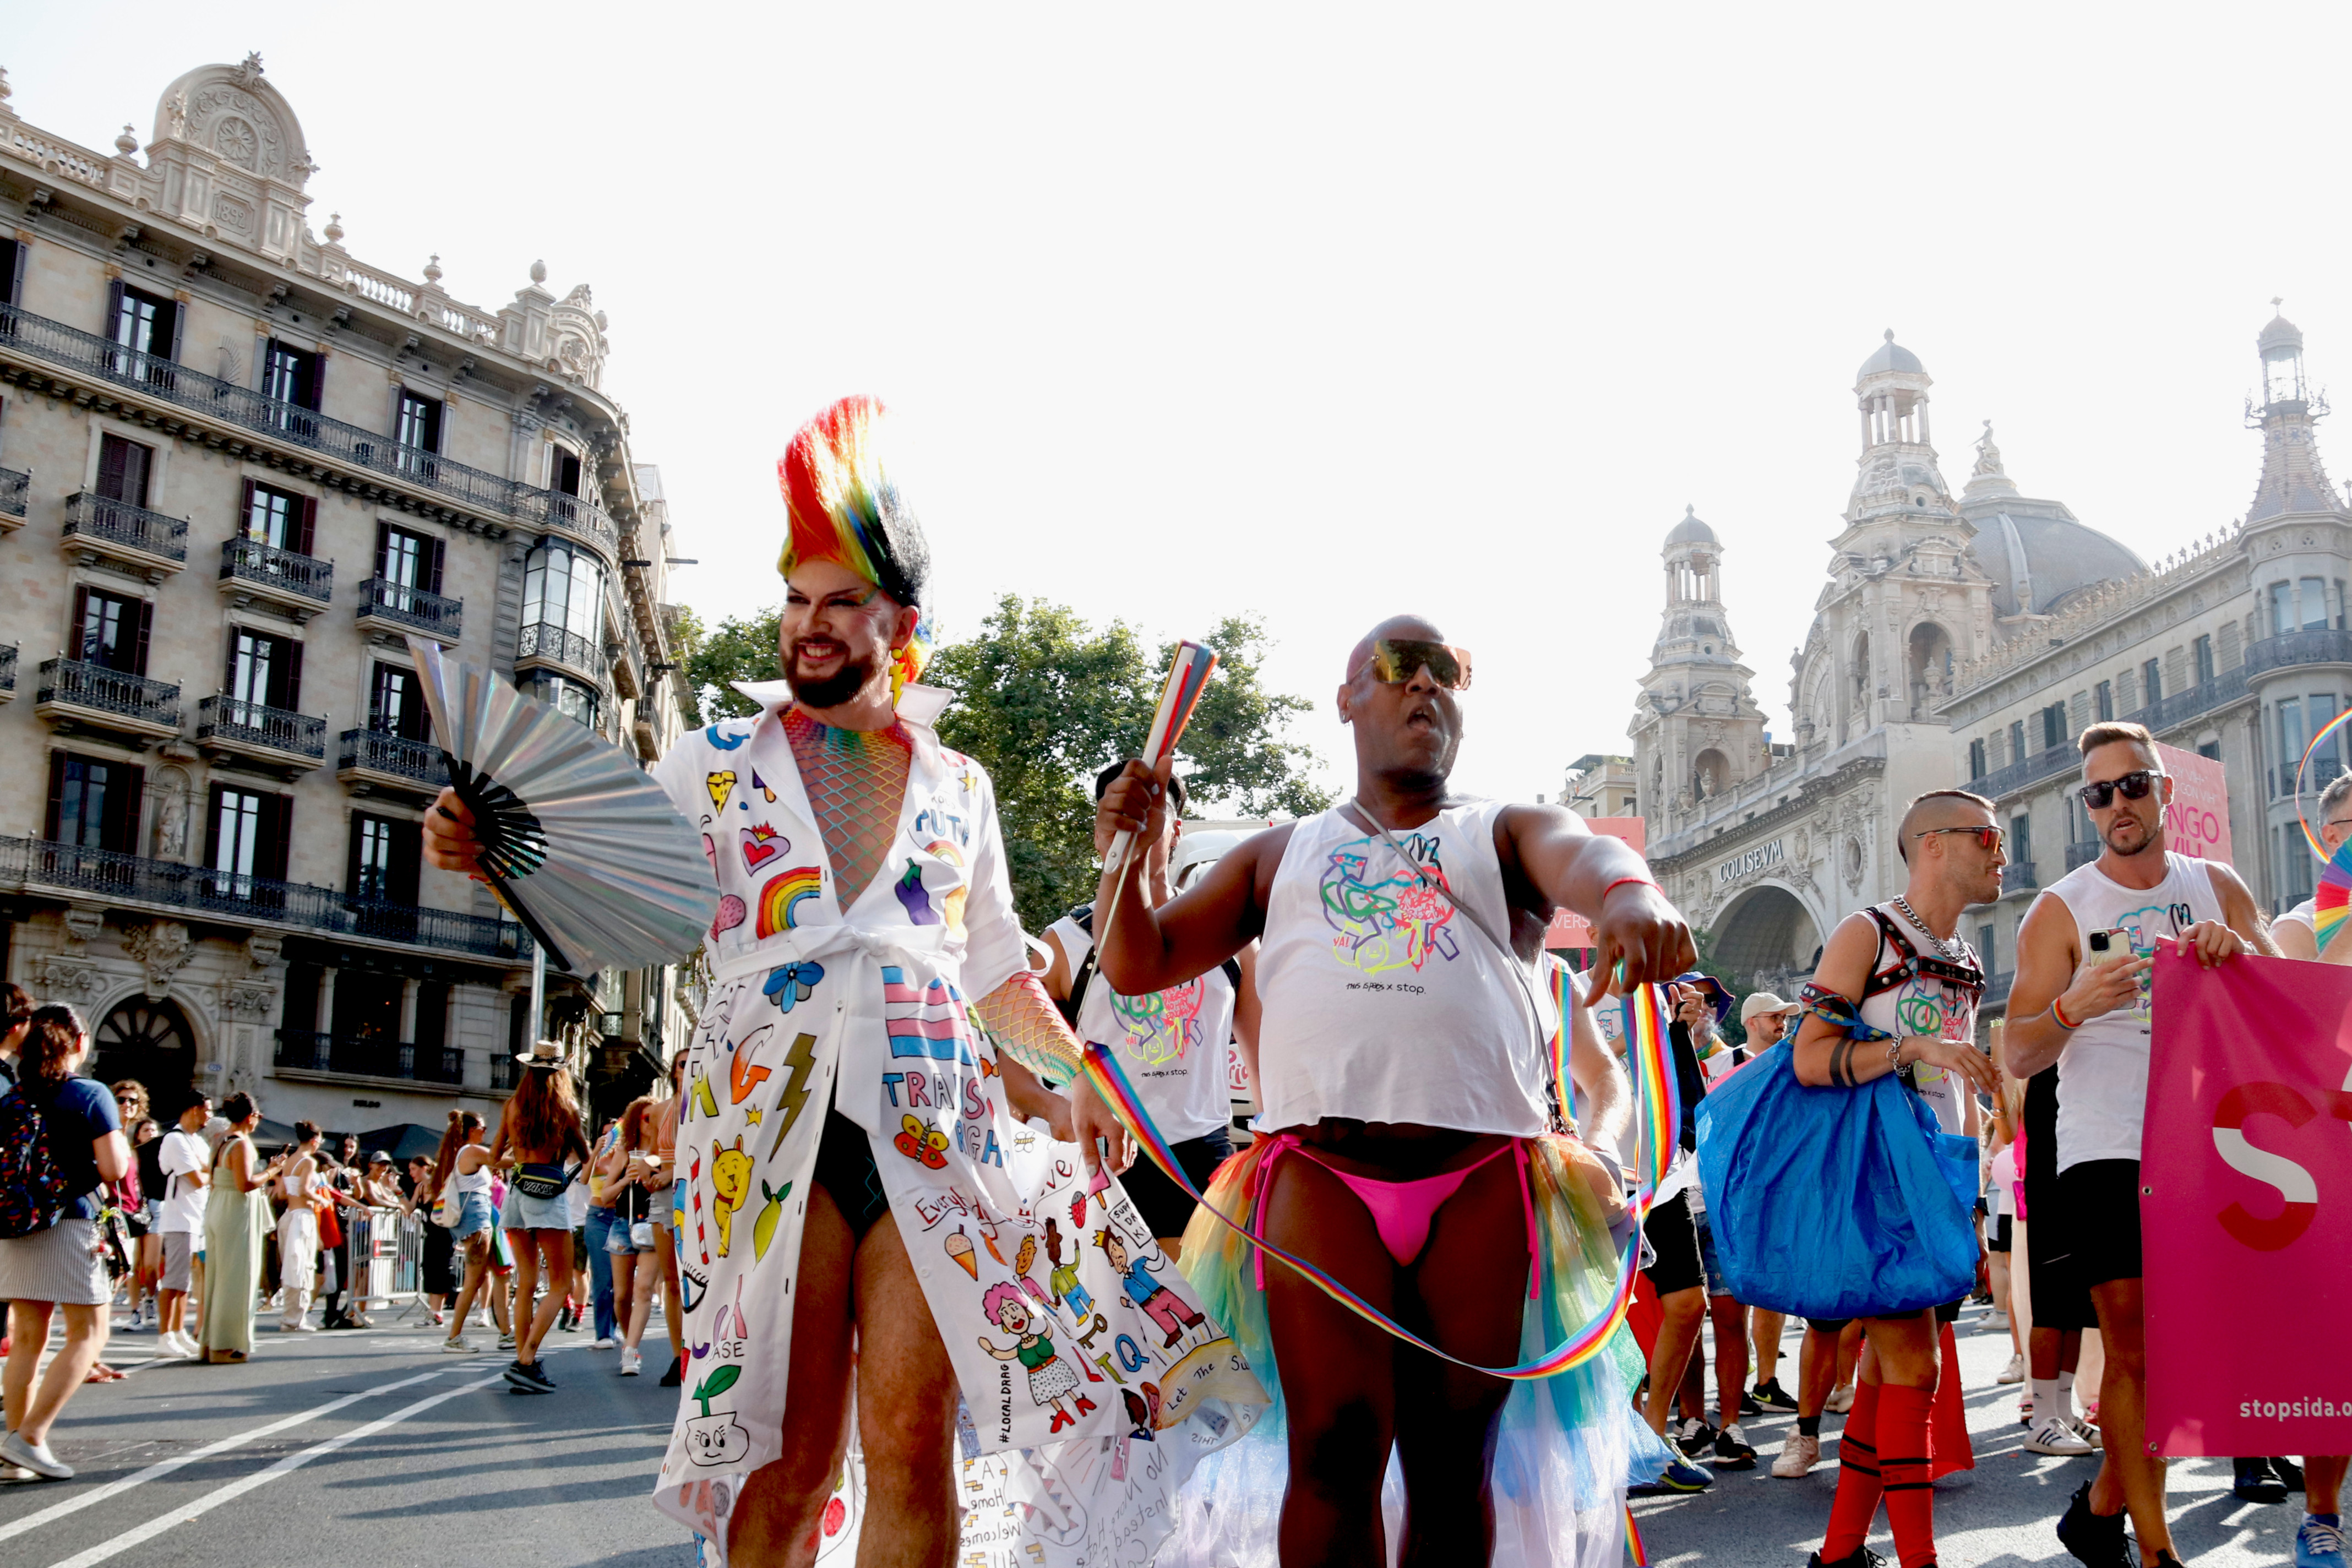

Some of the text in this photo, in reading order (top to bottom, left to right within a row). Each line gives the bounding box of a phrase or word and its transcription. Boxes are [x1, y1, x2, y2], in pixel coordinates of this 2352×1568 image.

[2165, 802, 2220, 844] NGO
[1549, 914, 1591, 929] VERS
[2213, 1081, 2352, 1251] S
[522, 1181, 553, 1195] VANS
[1167, 1387, 1187, 1410] Let
[1194, 1363, 1215, 1379] The
